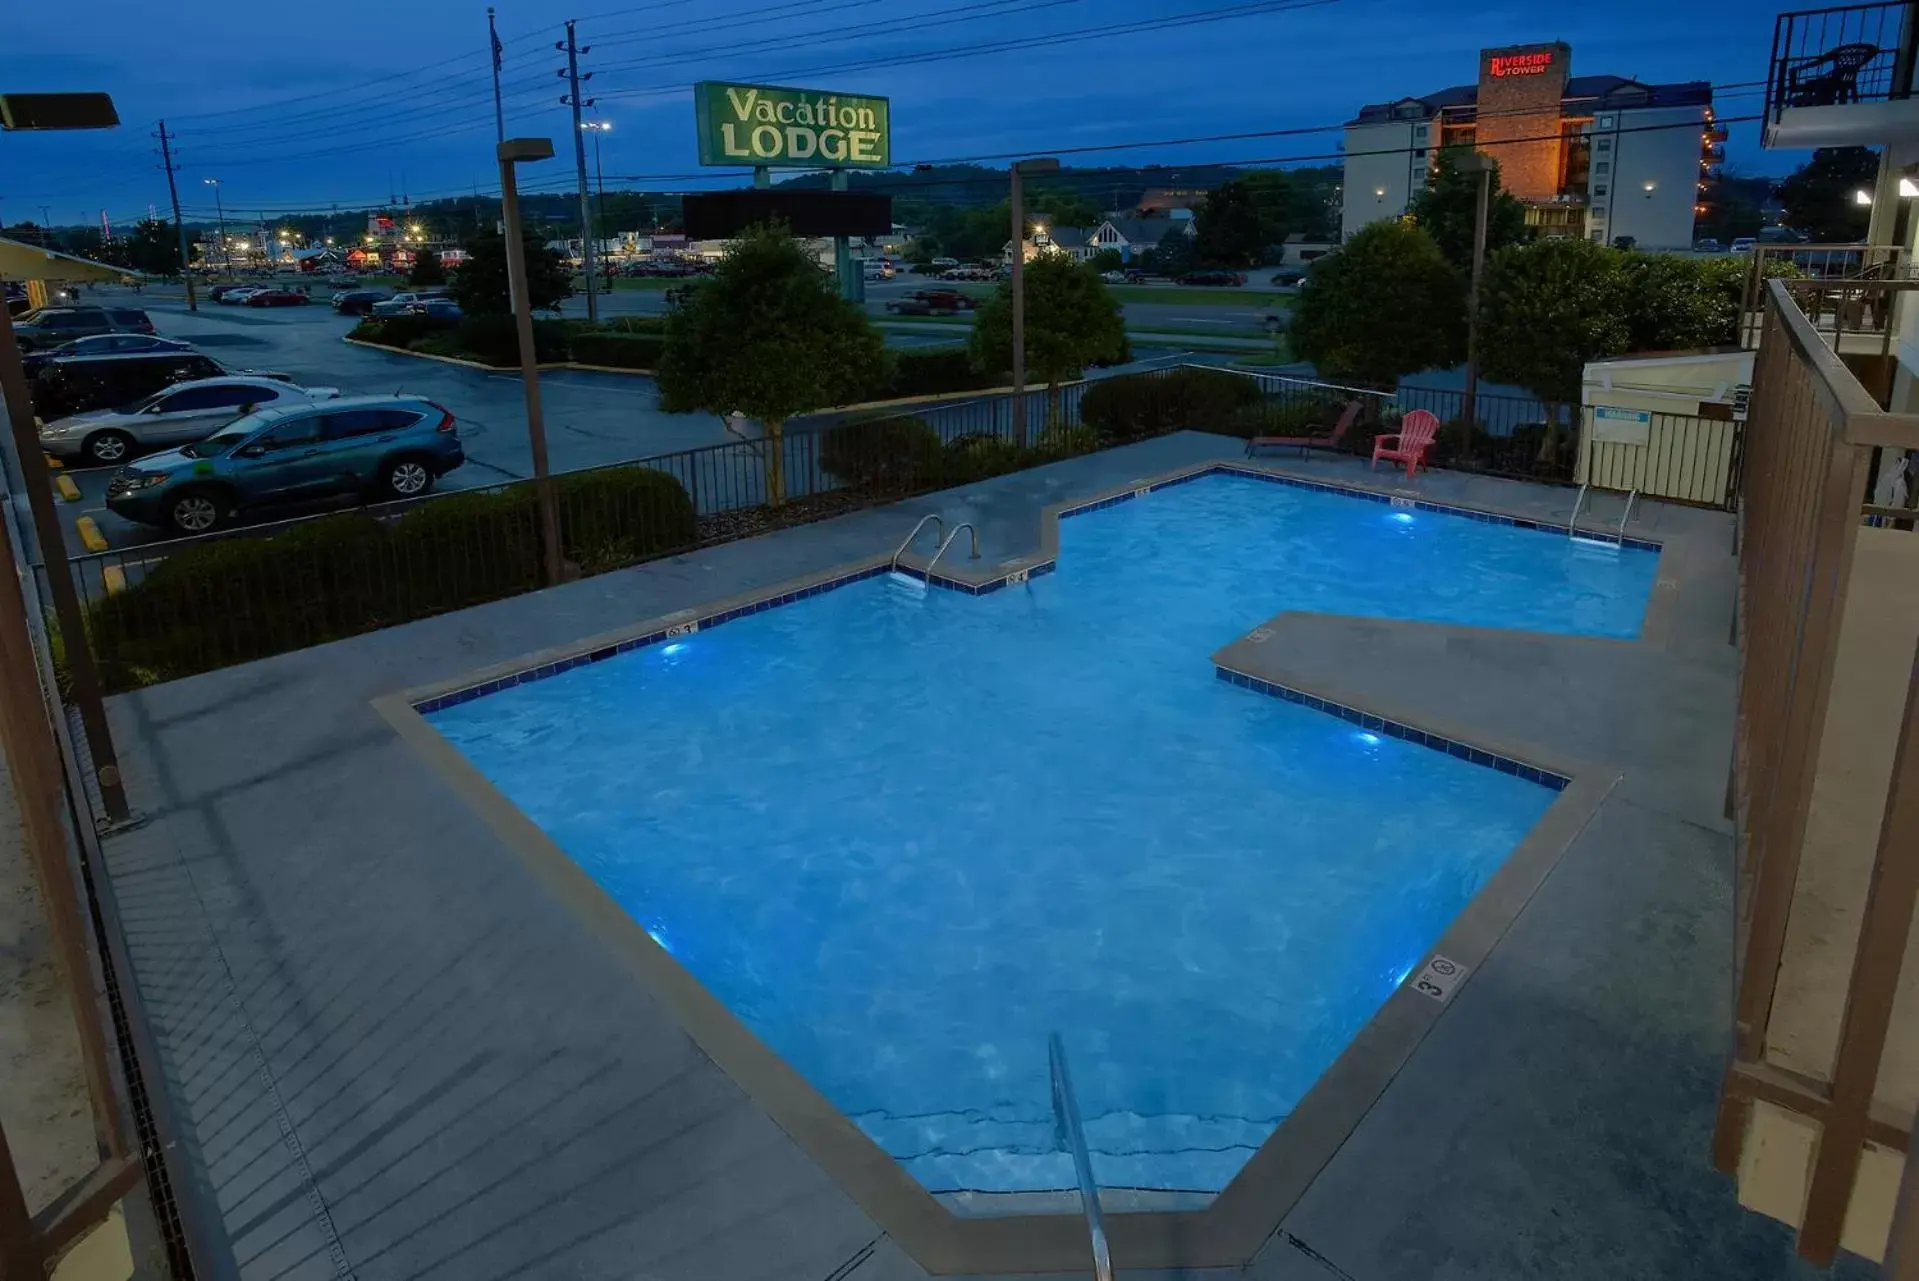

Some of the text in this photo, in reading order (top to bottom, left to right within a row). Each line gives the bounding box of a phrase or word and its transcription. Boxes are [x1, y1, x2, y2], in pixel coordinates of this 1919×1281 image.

[1491, 53, 1552, 76] RIVERSIDE
[1506, 65, 1545, 75] TOWER
[726, 88, 876, 130] Vacation
[722, 123, 882, 161] LODGE
[1418, 981, 1442, 996] 3
